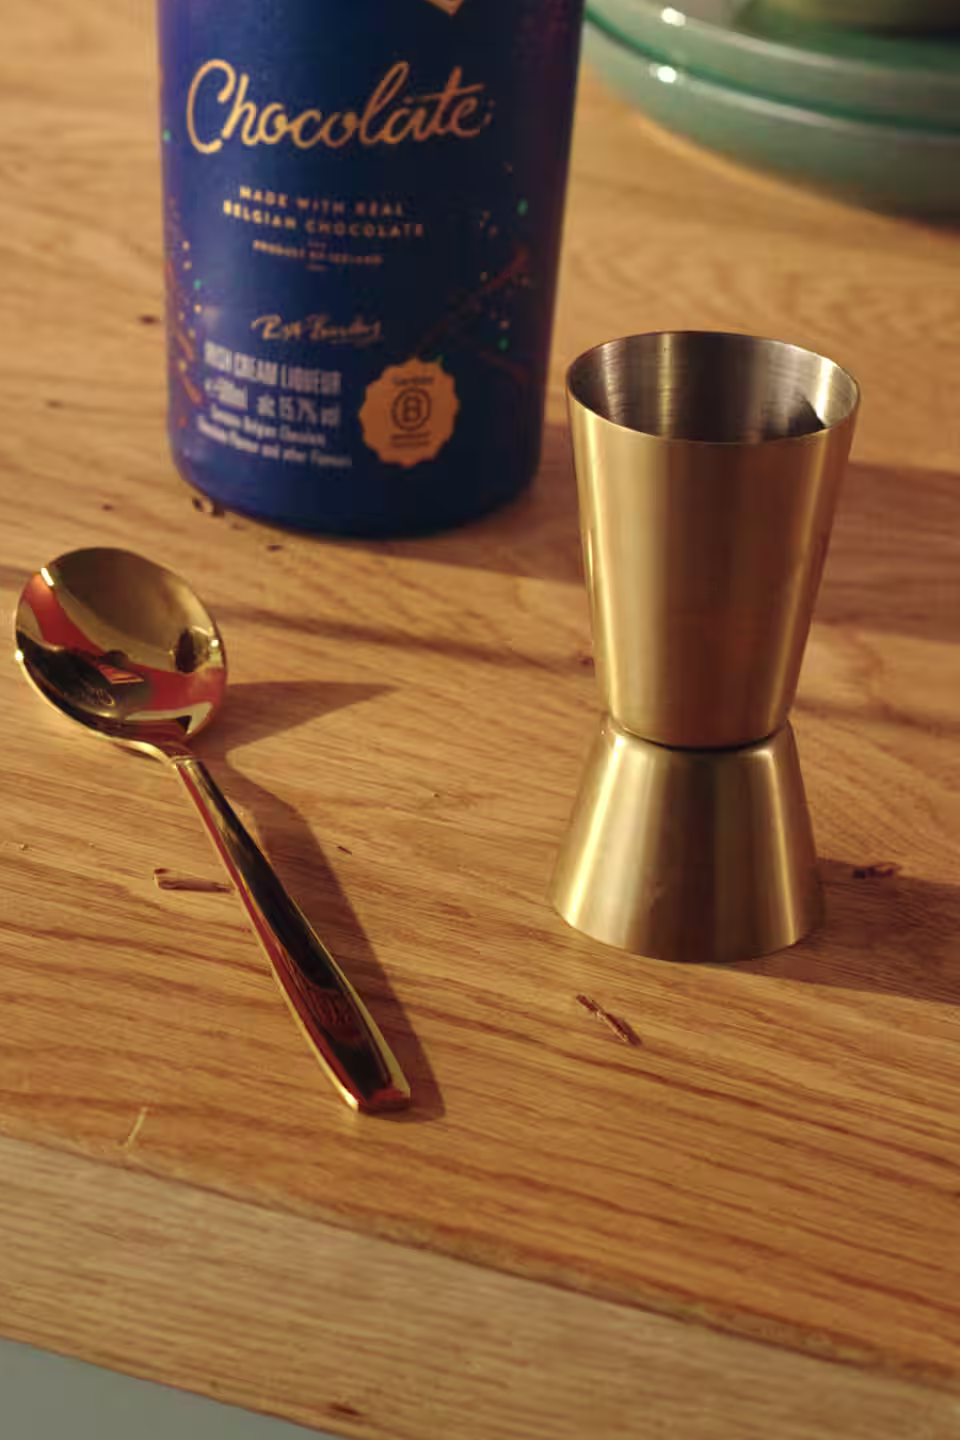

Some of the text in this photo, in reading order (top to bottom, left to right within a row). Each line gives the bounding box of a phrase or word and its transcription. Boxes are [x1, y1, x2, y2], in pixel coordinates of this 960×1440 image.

[186, 59, 492, 154] Chocolate
[223, 199, 424, 239] BELGIAN CHOCOLATE
[240, 186, 404, 217] MADE WITH REAL
